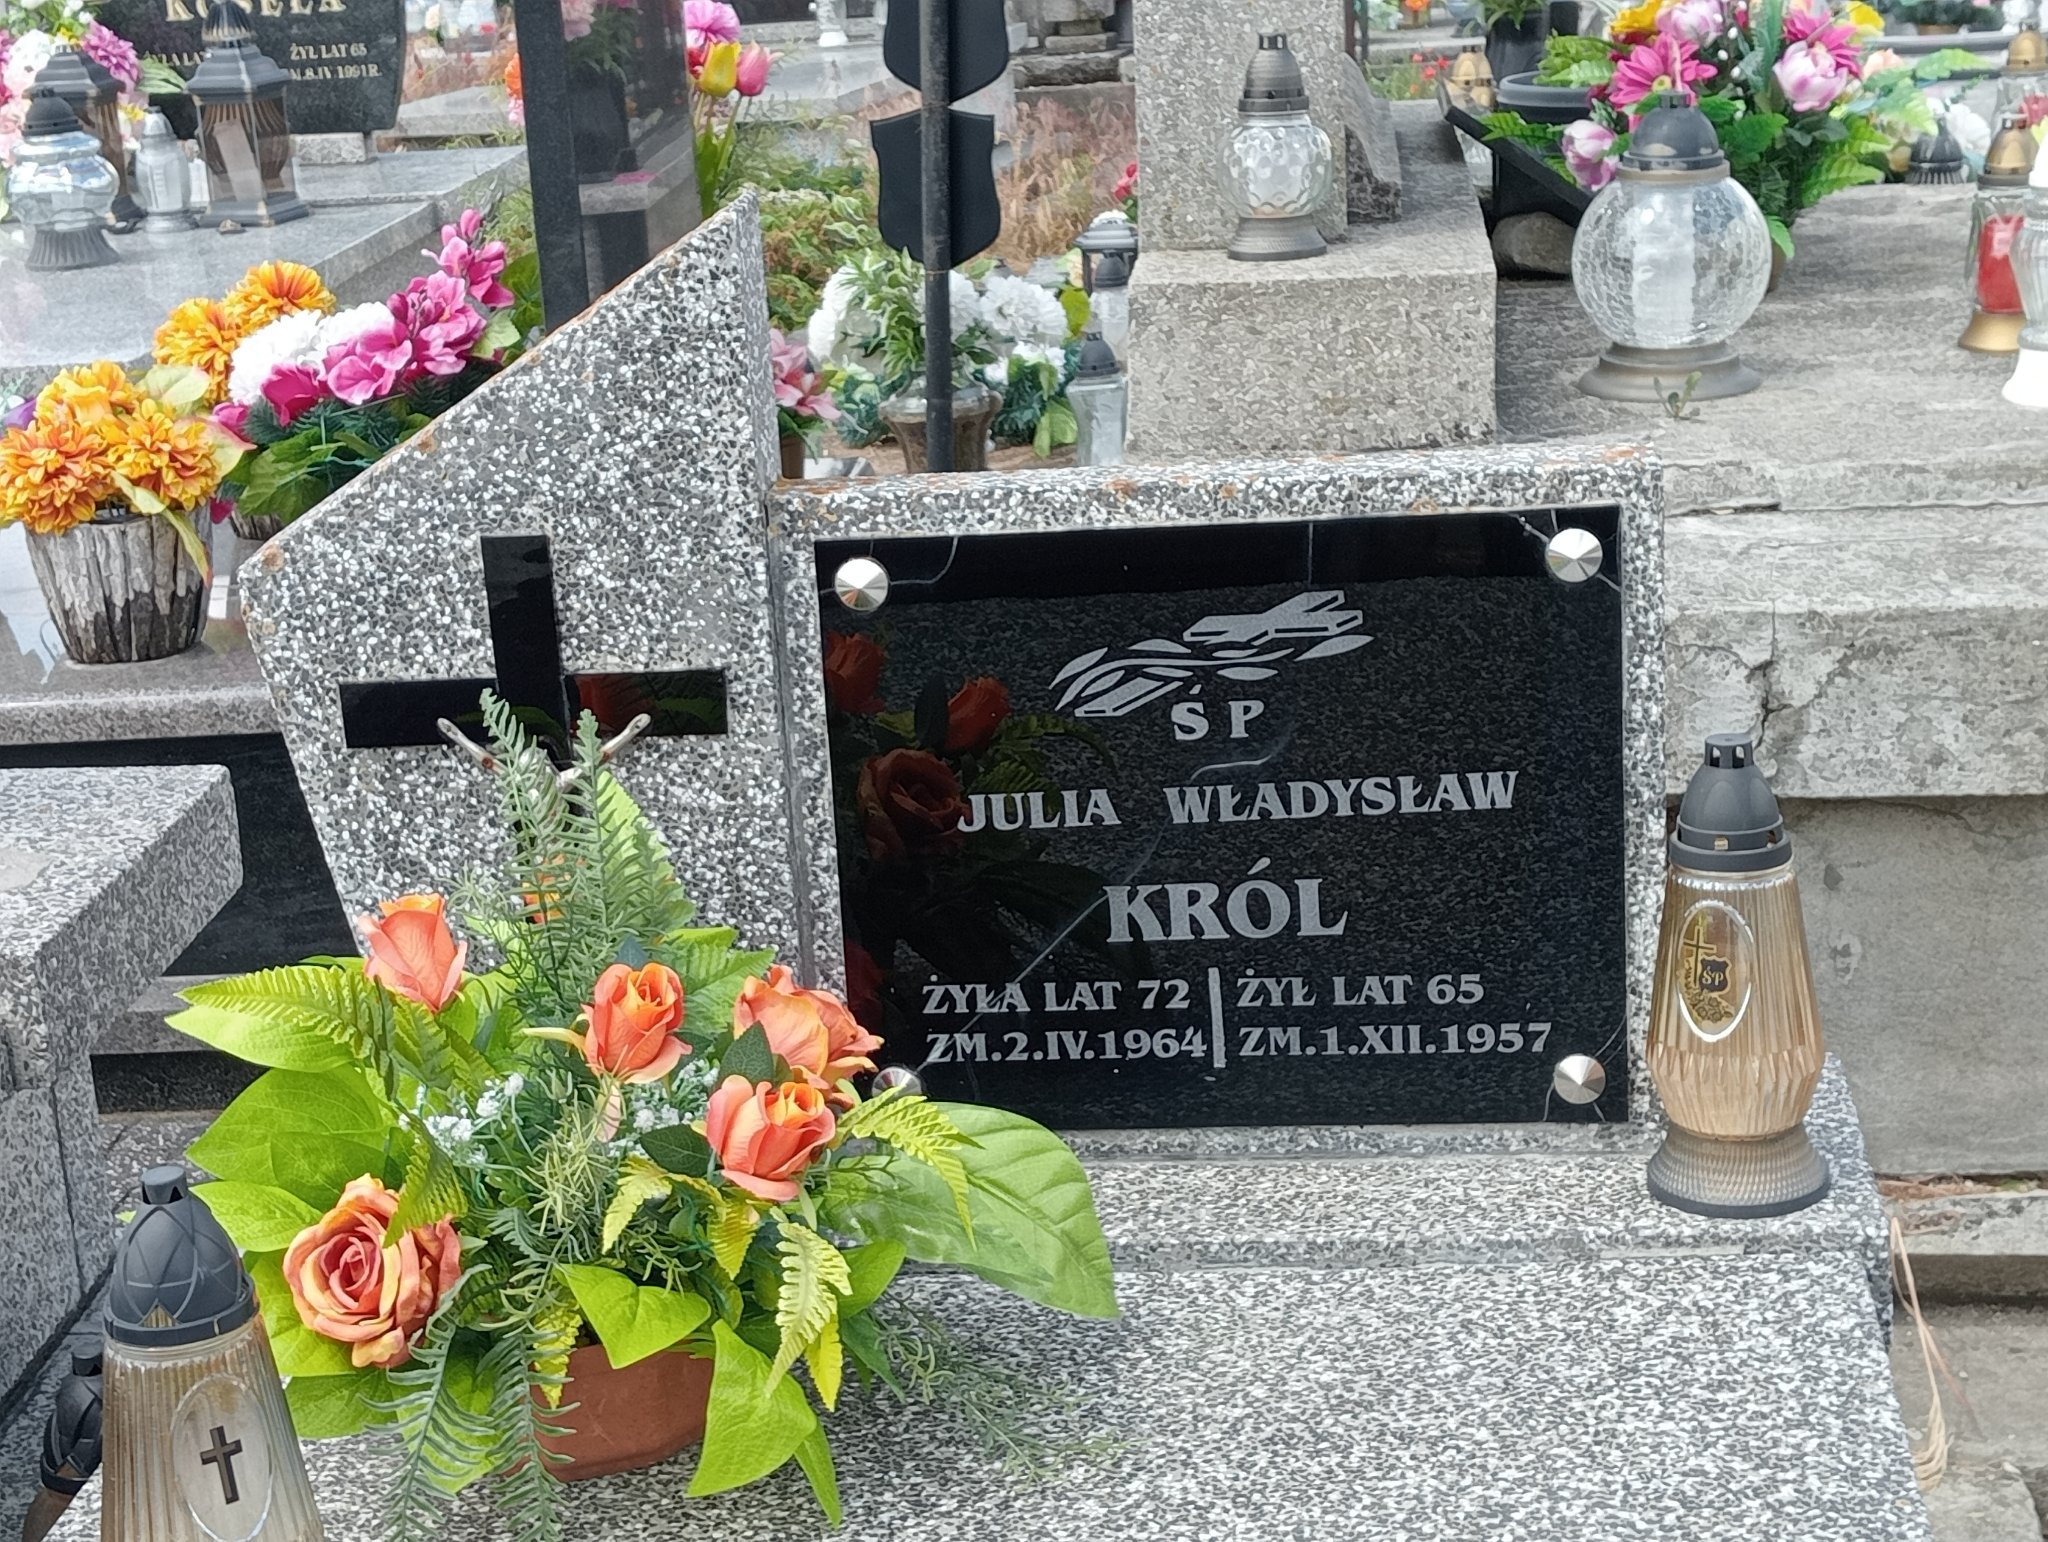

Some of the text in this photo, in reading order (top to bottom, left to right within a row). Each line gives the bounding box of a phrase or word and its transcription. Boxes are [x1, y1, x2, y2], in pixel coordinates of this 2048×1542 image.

[320, 44, 348, 58] LAT
[1171, 684, 1265, 741] Ś P
[957, 771, 1519, 833] JULIA WŁADYSŁAW
[1102, 857, 1348, 943] KRÓL
[922, 974, 1191, 1014] ŻYŁA LAT 72
[1236, 968, 1485, 1007] ŻYŁ LAT 65
[926, 1025, 1207, 1063] ZM.2.IV.1964
[1238, 1022, 1552, 1057] ZM.1.XII.1957
